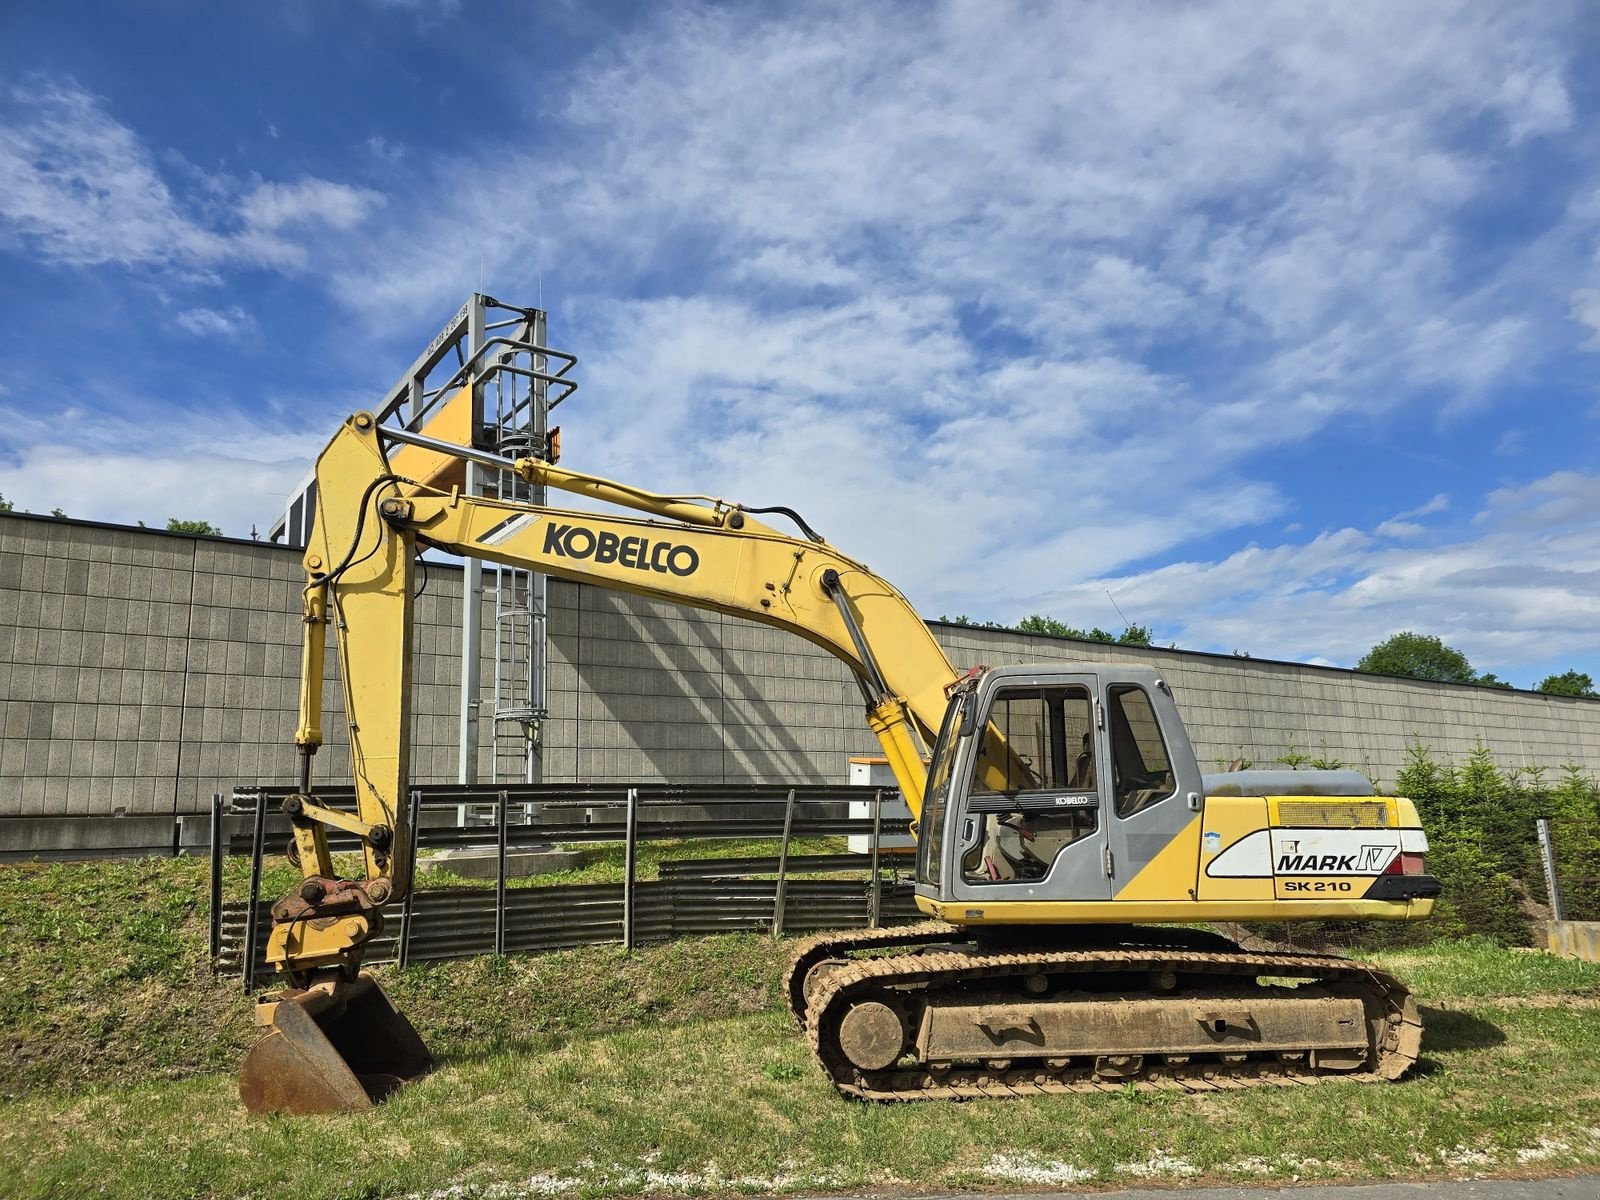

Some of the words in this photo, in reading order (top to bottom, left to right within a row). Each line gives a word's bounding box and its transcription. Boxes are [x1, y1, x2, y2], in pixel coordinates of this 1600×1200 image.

[542, 522, 699, 576] KOBELCO
[1055, 796, 1088, 805] KOBELCO
[1277, 855, 1357, 870] MARK
